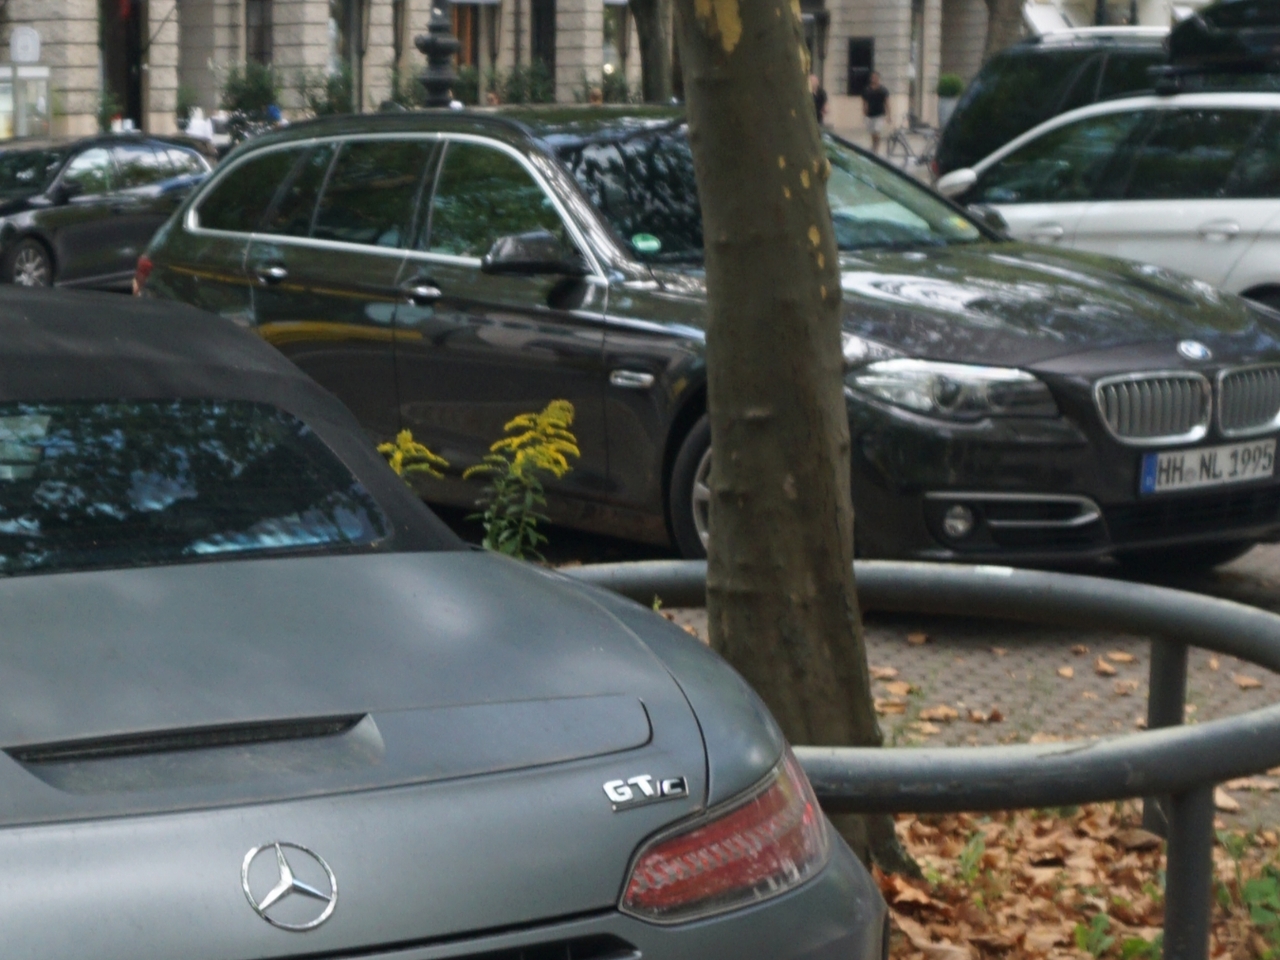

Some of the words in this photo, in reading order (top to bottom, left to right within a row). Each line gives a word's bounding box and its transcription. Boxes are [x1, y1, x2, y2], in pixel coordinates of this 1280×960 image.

[1157, 456, 1185, 486] HH
[1200, 450, 1222, 480] NL
[1228, 442, 1273, 478] 1995
